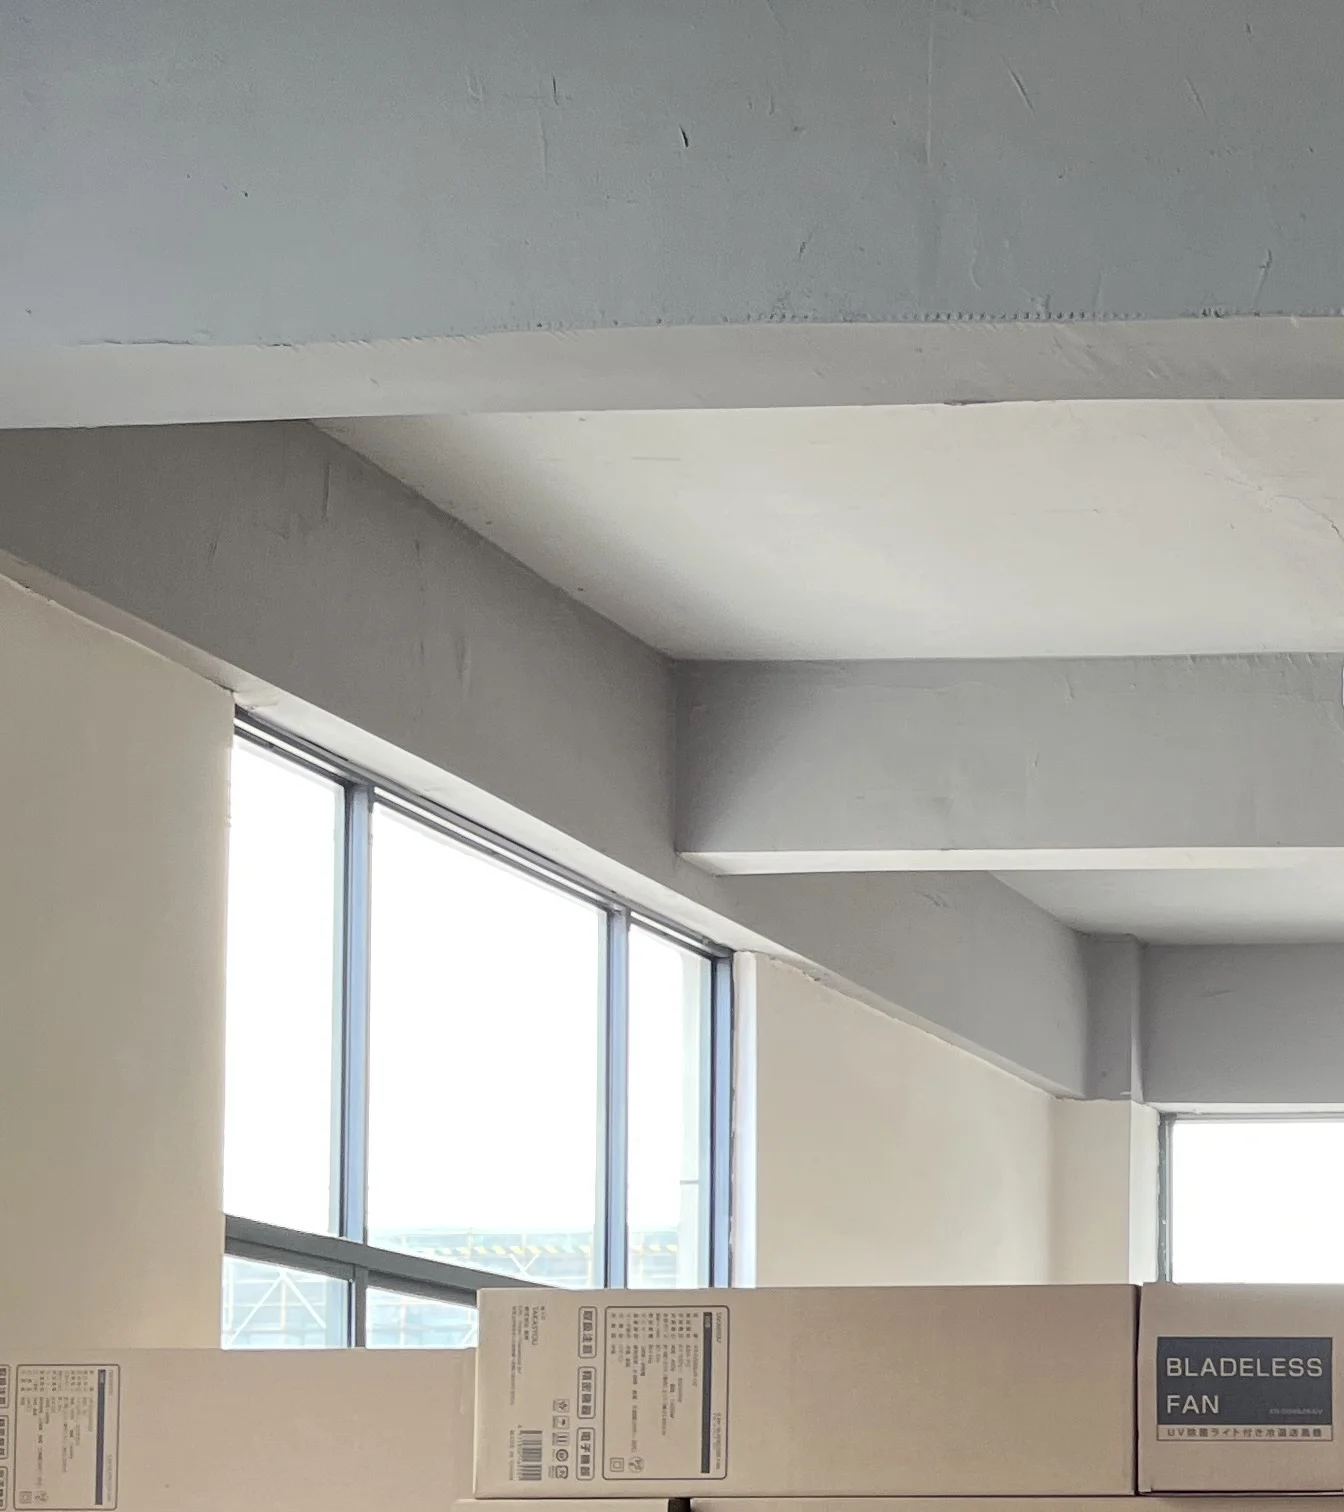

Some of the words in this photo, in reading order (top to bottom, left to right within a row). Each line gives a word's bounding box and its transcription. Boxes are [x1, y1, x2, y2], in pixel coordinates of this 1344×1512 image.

[582, 1311, 592, 1353] 取扱注意
[1167, 1358, 1322, 1376] BLADELESS
[1168, 1395, 1218, 1413] FAN
[581, 1432, 591, 1476] 電子機器
